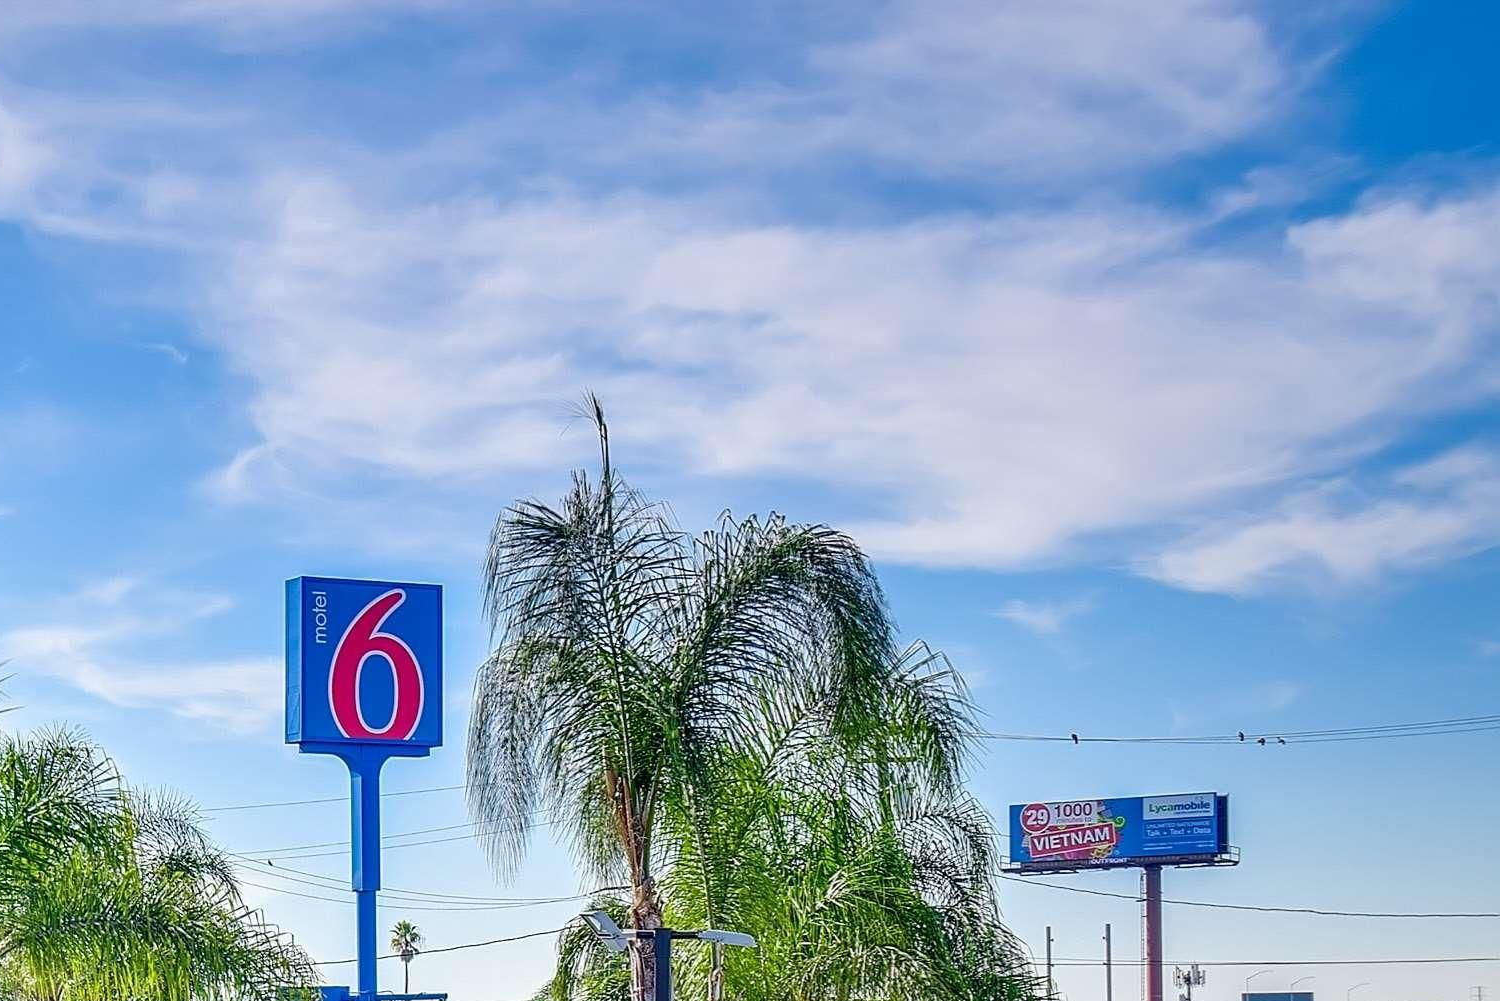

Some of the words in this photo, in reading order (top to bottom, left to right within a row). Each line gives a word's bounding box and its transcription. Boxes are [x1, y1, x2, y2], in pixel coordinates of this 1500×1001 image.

[312, 591, 327, 644] motel
[328, 588, 425, 740] 6
[1055, 803, 1092, 817] 1000
[1149, 801, 1211, 814] Lycamobile
[1033, 827, 1110, 851] VIETNAM
